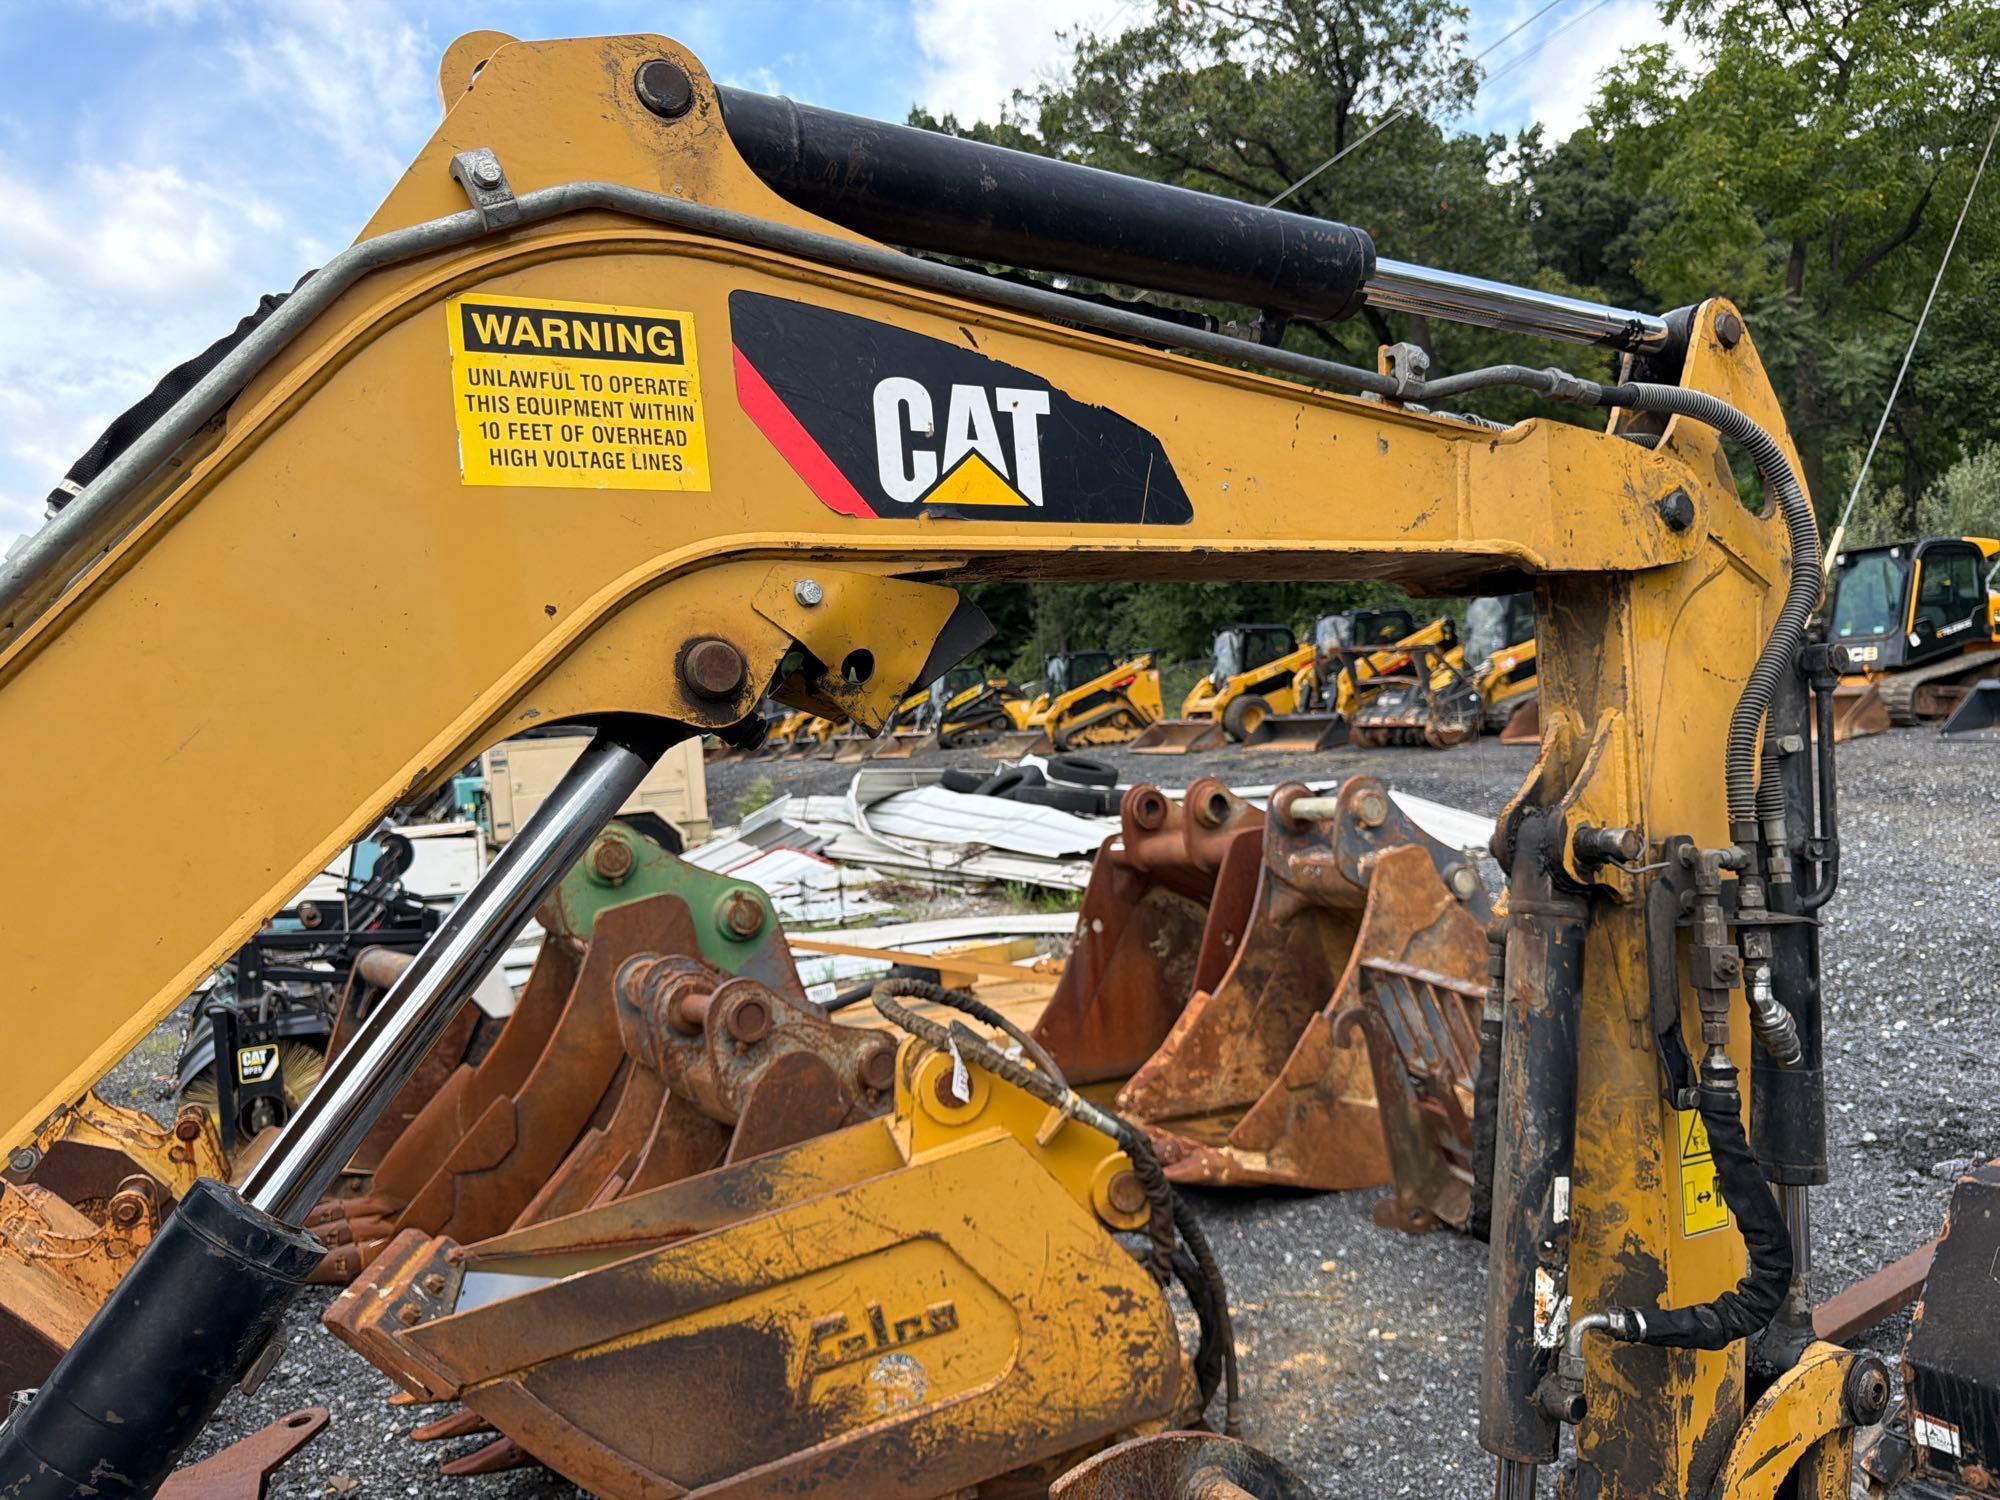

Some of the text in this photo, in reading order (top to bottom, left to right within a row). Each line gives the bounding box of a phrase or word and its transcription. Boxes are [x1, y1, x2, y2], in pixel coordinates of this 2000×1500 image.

[471, 312, 676, 356] WARNING
[468, 368, 688, 397] UNLAWFUL TO OPERATE
[465, 394, 694, 422] THIS EQUIPMENT WITHIN
[479, 421, 688, 447] 10 FEET OF OVERHEAD
[873, 376, 1050, 507] CAT
[489, 448, 683, 472] HIGH VOLTAGE LINES
[1847, 647, 1878, 662] CB
[242, 1050, 267, 1066] CAT
